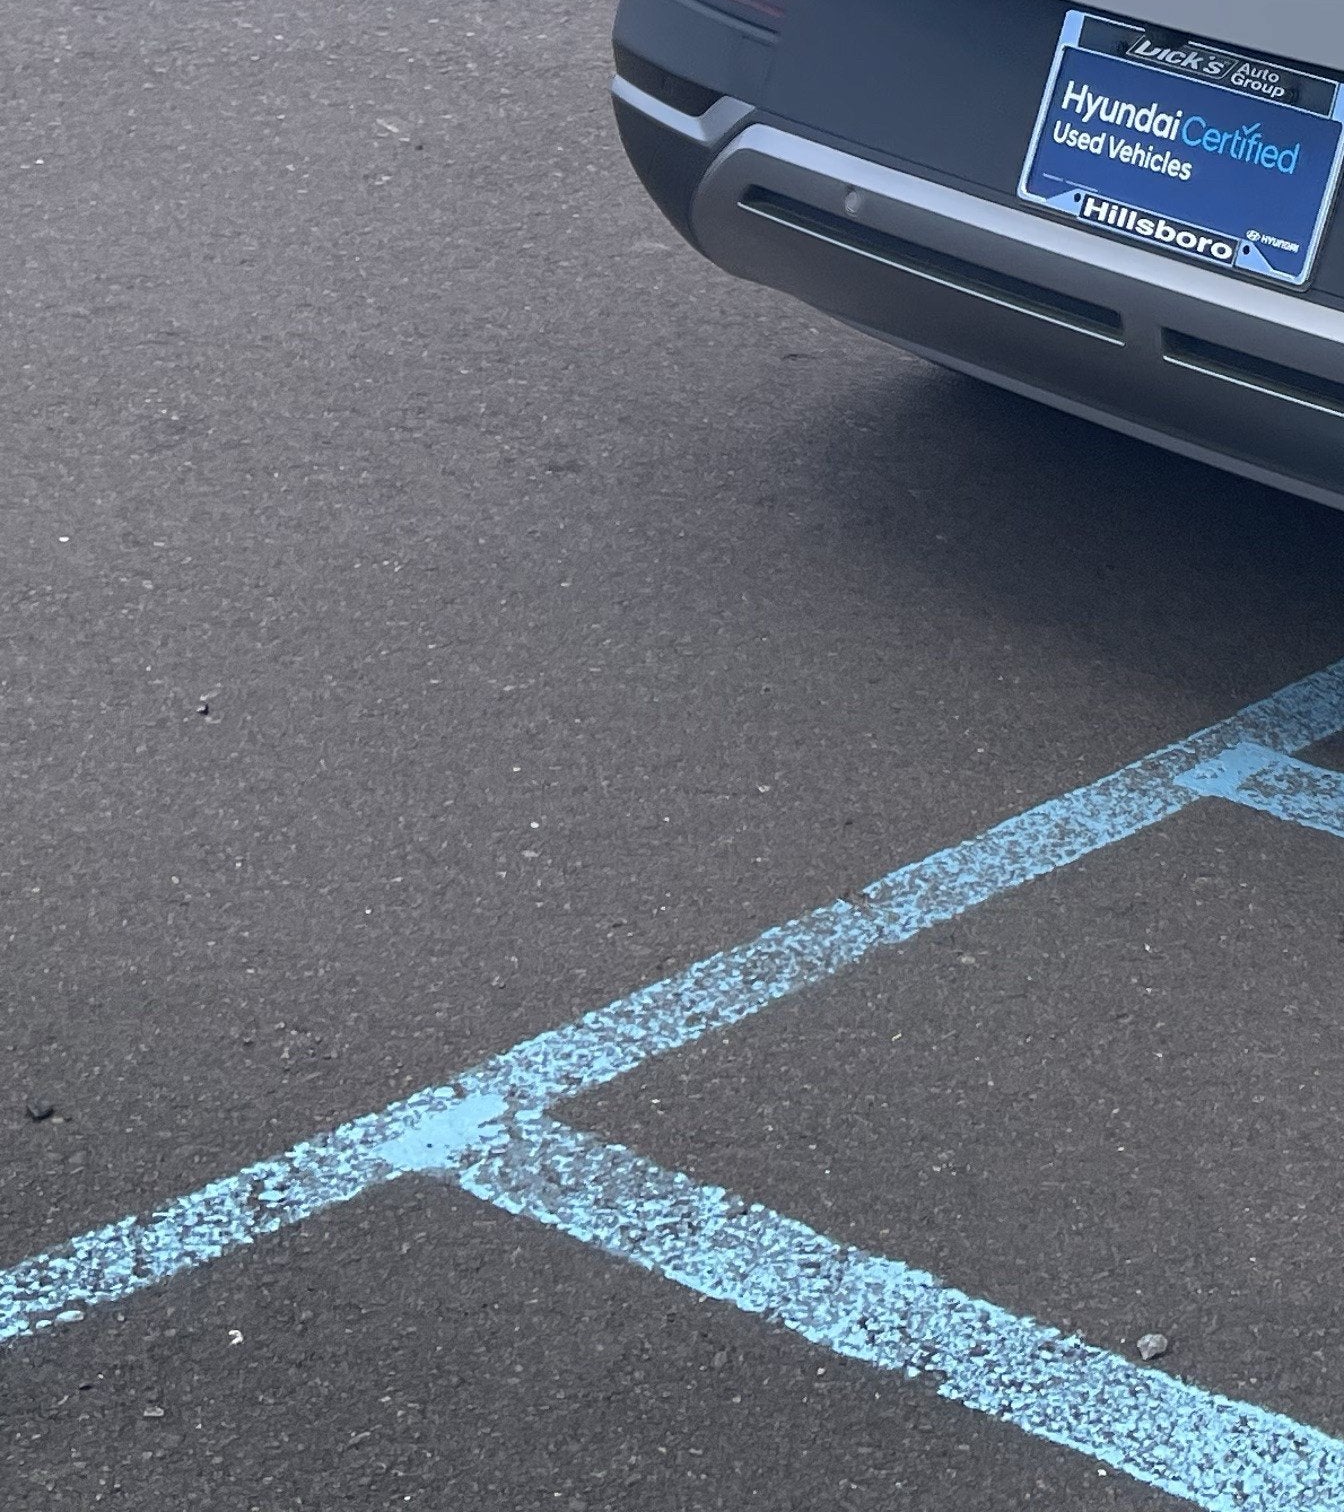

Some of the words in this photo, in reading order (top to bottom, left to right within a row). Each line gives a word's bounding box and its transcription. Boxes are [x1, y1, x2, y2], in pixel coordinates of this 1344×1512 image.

[1134, 39, 1225, 75] Dick's
[1237, 63, 1280, 83] Auto
[1230, 72, 1285, 98] Group
[1053, 120, 1105, 155] Used
[1109, 135, 1193, 181] Vehicles
[1061, 80, 1183, 141] Hyundai
[1181, 116, 1300, 175] Certified
[1083, 197, 1233, 260] Hillsboro
